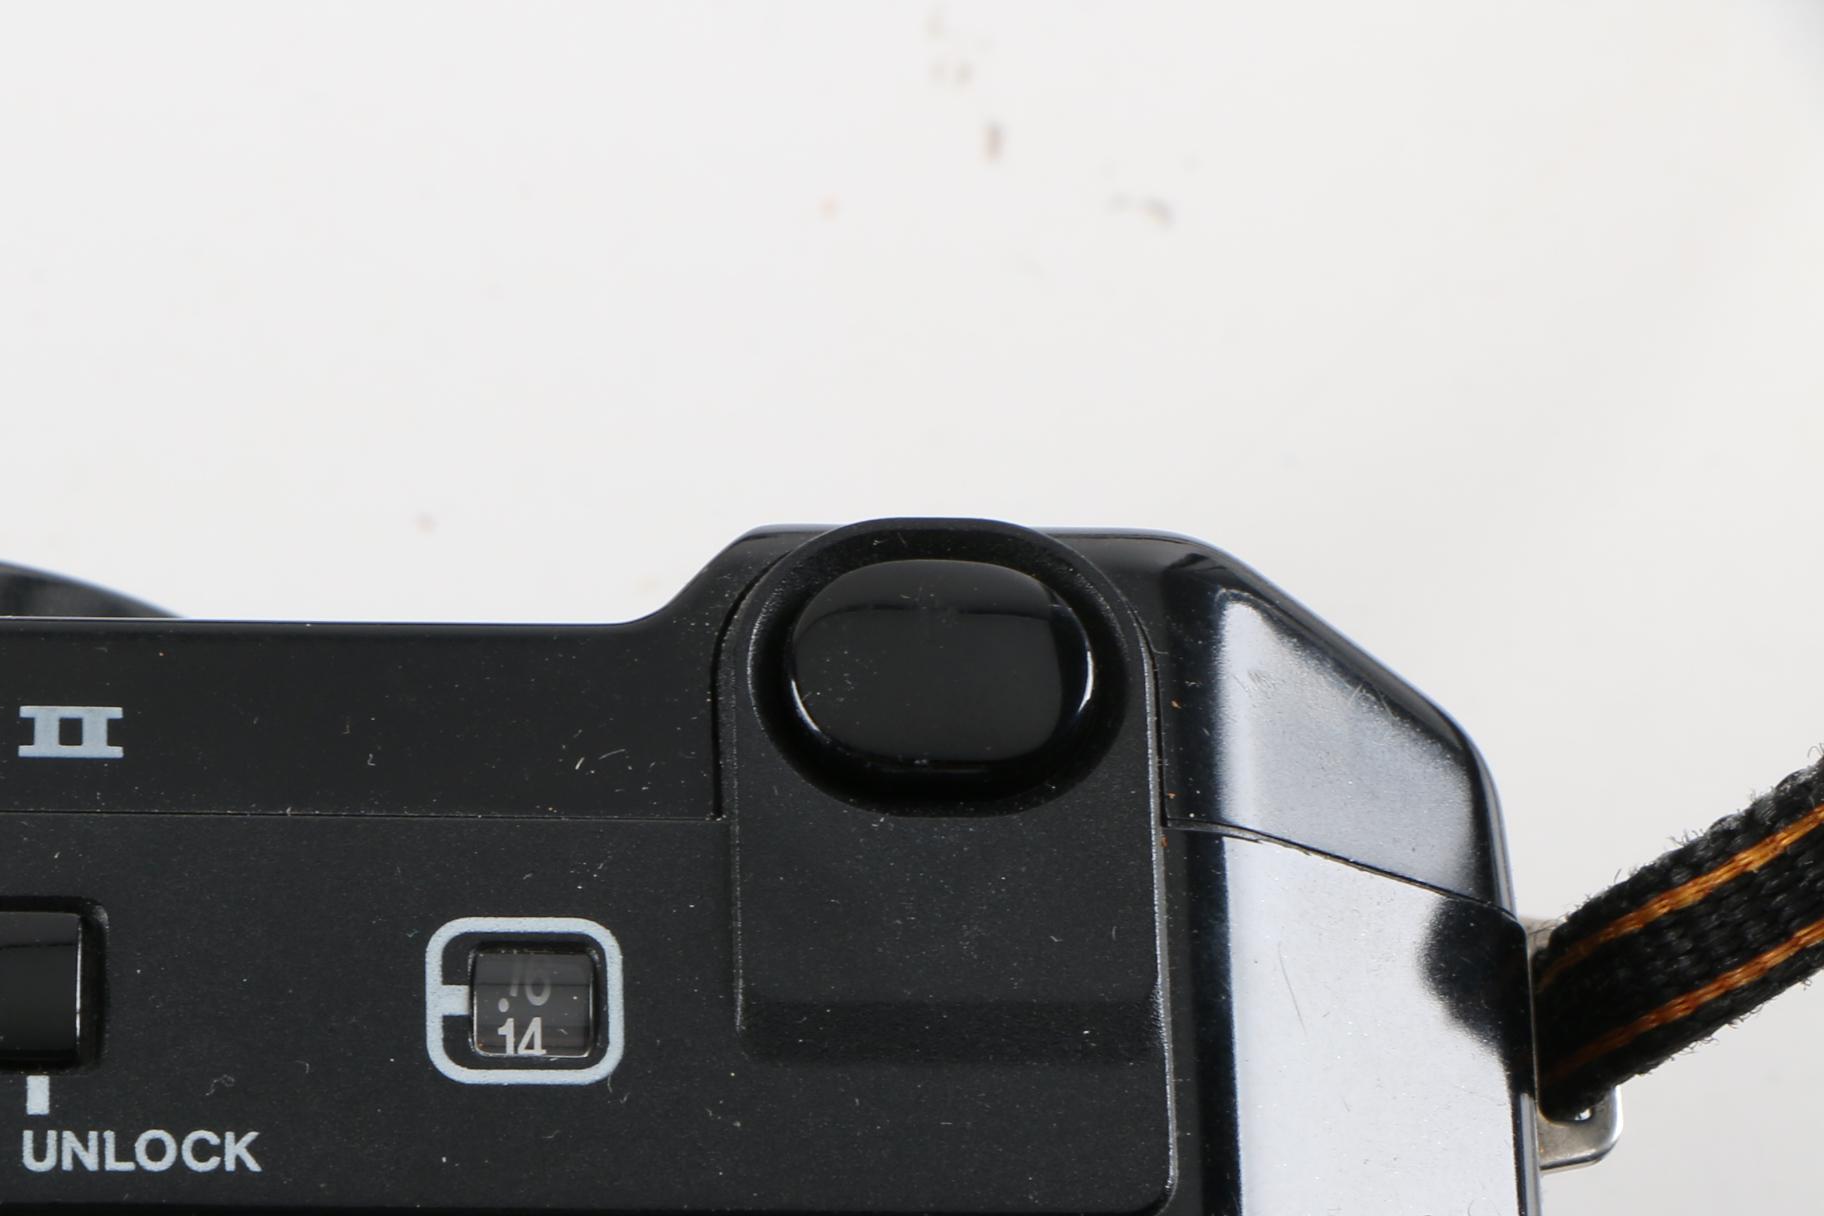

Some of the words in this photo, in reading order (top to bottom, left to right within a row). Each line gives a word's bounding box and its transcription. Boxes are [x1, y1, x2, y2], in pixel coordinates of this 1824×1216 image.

[17, 704, 124, 758] II
[497, 1016, 548, 1056] 14
[21, 1128, 263, 1173] UNLOCK
